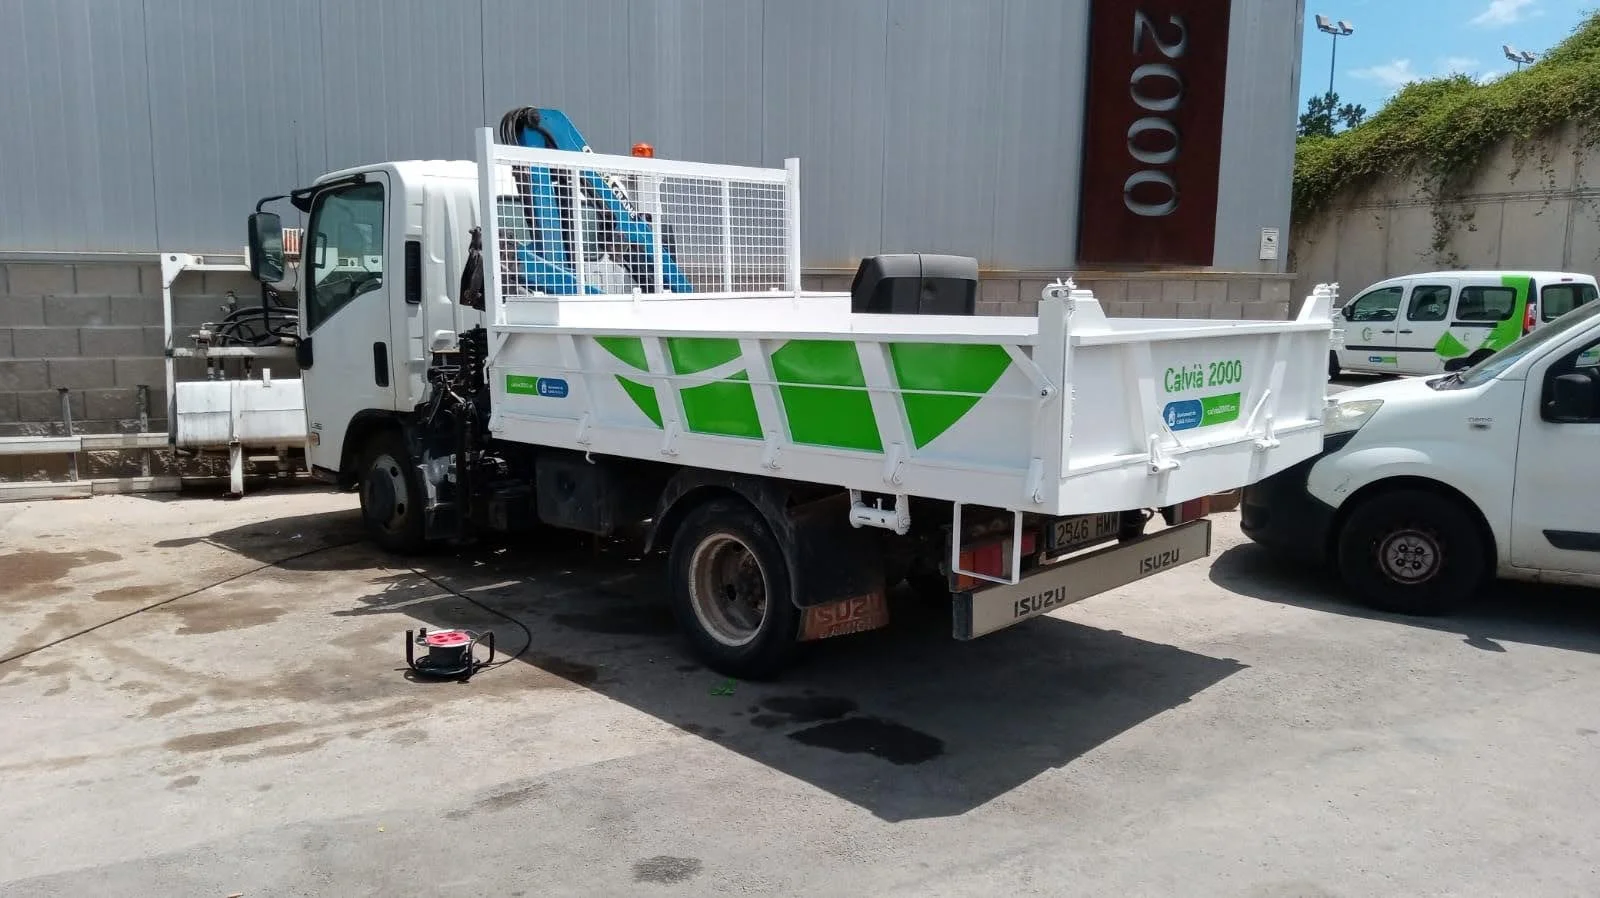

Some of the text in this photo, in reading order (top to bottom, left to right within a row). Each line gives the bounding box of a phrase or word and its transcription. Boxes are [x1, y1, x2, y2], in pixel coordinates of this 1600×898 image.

[1123, 9, 1187, 217] 2000
[1164, 359, 1242, 393] Calvià 2000
[1057, 518, 1089, 545] 2546
[1139, 549, 1180, 575] ISUZU
[1014, 586, 1066, 618] ISUZU
